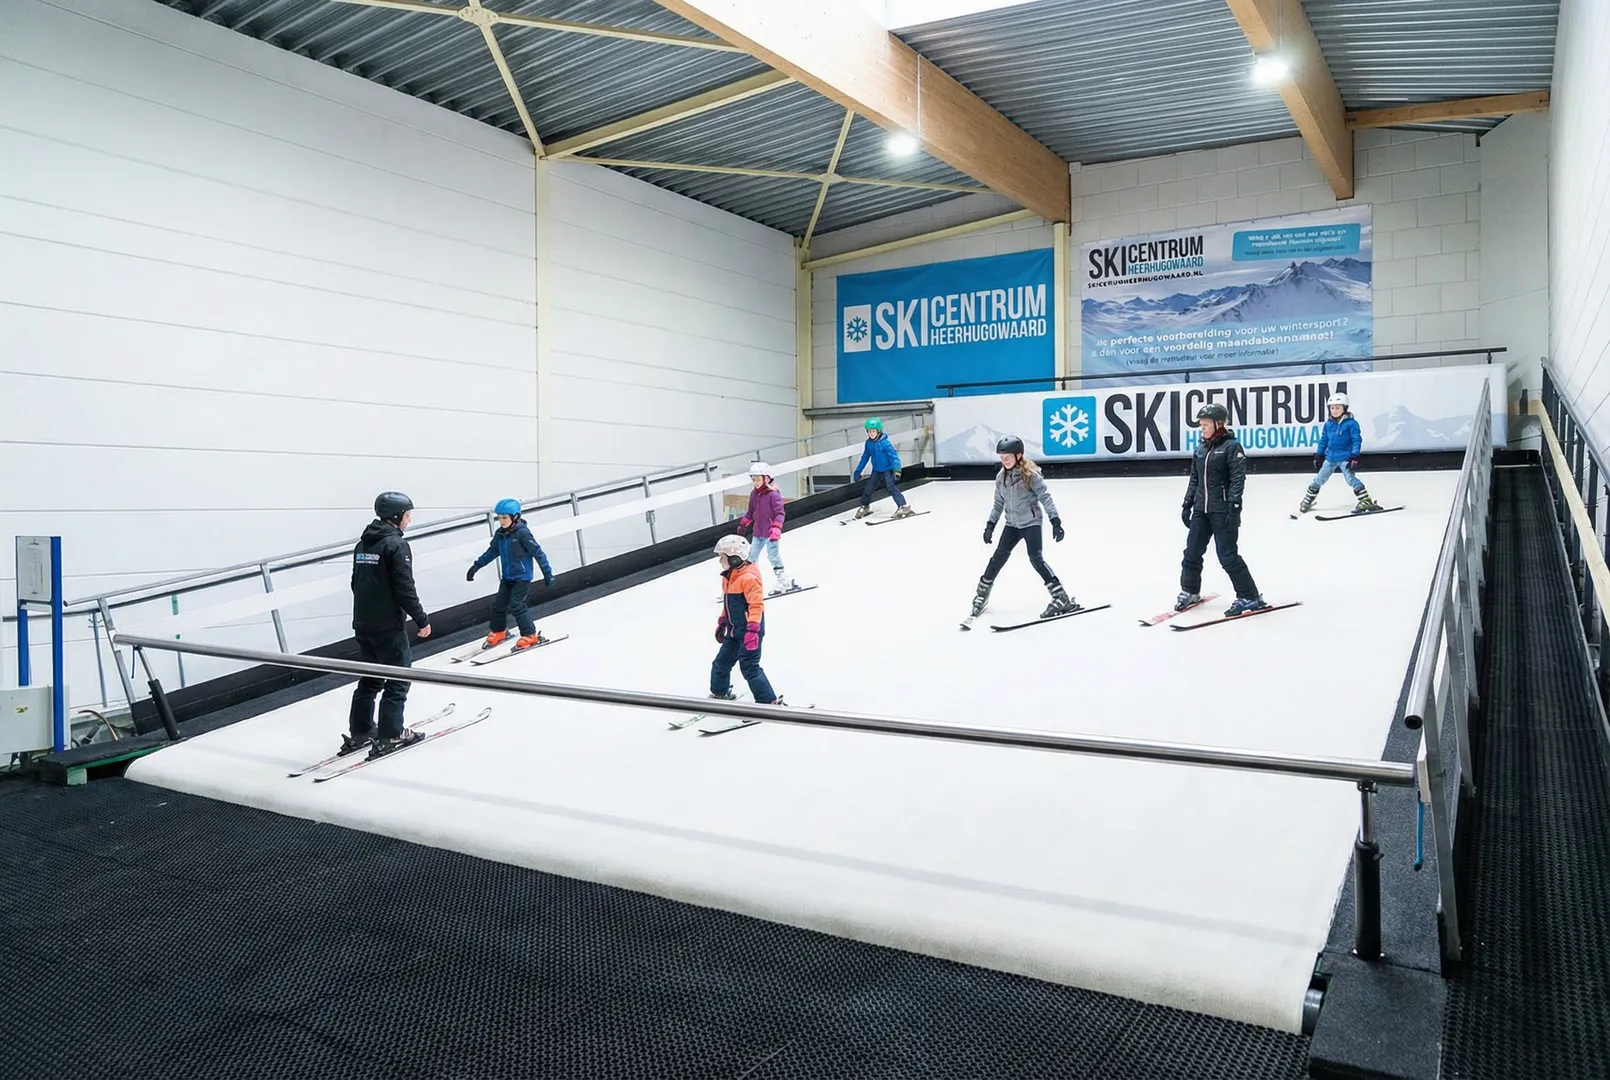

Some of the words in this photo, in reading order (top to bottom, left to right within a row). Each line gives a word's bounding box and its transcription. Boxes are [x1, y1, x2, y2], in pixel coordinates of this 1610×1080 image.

[1089, 246, 1127, 279] SKI
[1128, 235, 1204, 263] CENTRUM
[1128, 256, 1204, 275] HEERHUGOWAARD
[875, 298, 928, 351] SKI
[931, 284, 1046, 327] CENTRUM
[1234, 327, 1258, 336] voor
[1261, 325, 1276, 334] uw
[931, 319, 1046, 346] HEERHUGOWAARD
[1119, 346, 1141, 356] voor
[1163, 340, 1213, 352] voordelig
[1104, 391, 1180, 454] SKI
